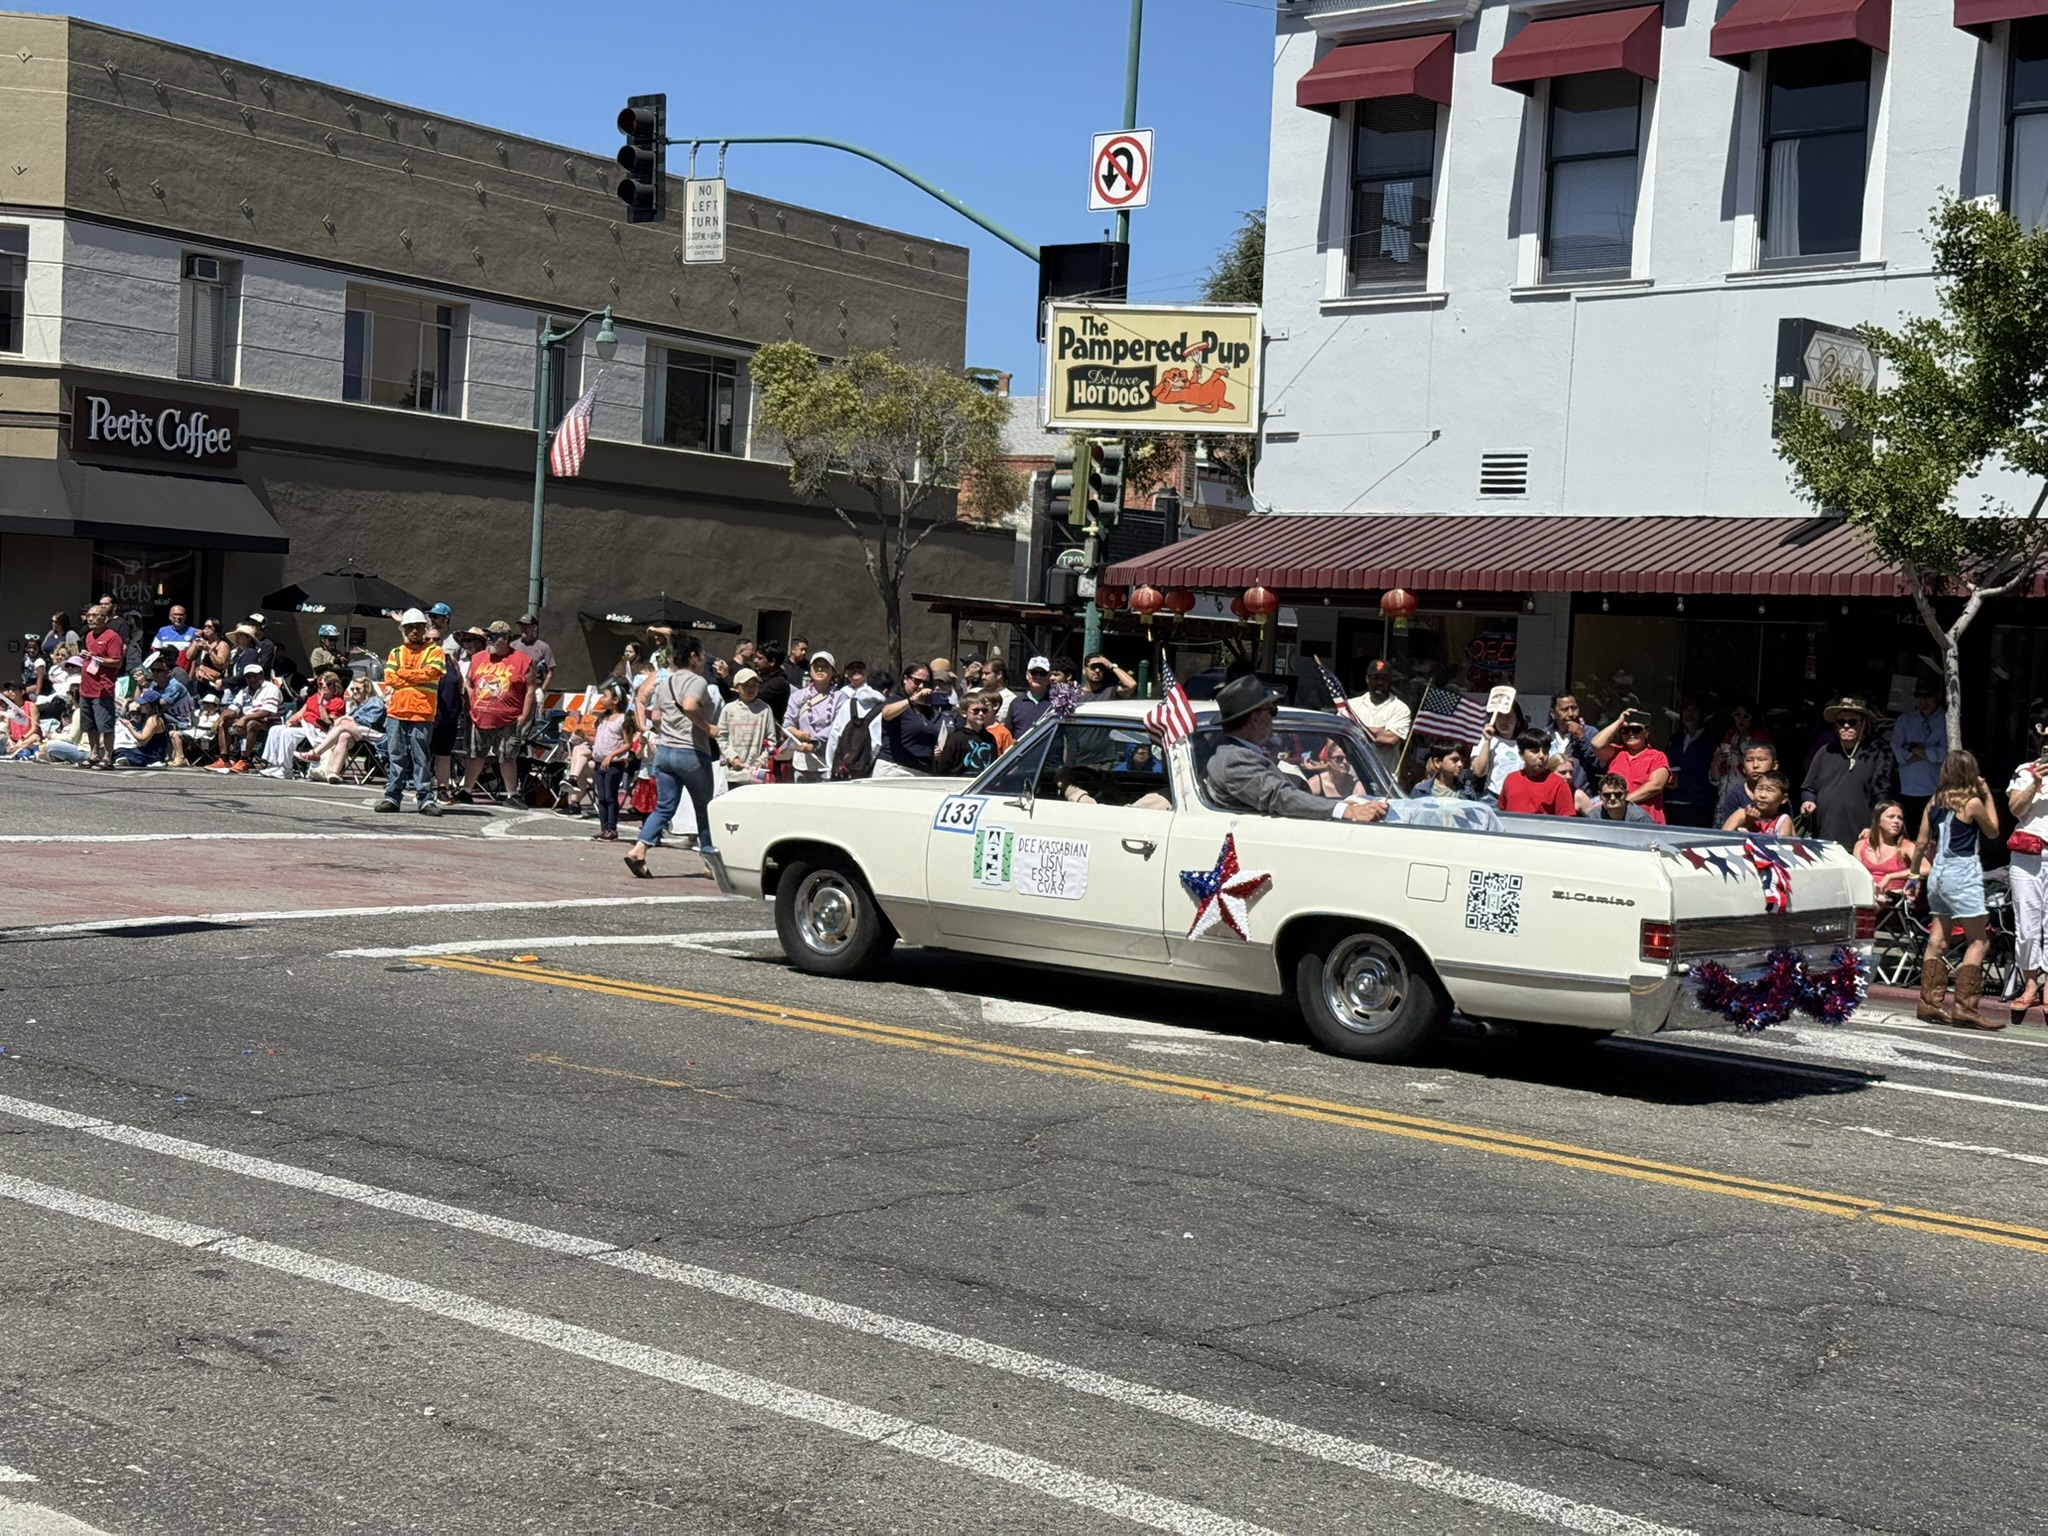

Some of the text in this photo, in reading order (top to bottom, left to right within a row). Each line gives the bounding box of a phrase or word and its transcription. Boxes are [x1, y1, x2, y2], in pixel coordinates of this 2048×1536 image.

[699, 185, 712, 196] NO
[692, 200, 718, 212] LEFT
[691, 216, 719, 227] TURN
[1080, 316, 1109, 336] The
[1058, 326, 1250, 369] Pampered Pup
[1087, 369, 1141, 386] Deluxe
[1073, 380, 1150, 407] HOT DOGS
[86, 396, 231, 458] Peet's Coffee
[1471, 639, 1517, 662] OPE
[940, 802, 979, 825] 133
[1018, 837, 1089, 858] DEE KASSABIAN
[1040, 854, 1064, 871] USN
[1031, 867, 1067, 884] ESSEX
[1037, 881, 1065, 896] CVA9
[1552, 890, 1635, 907] El Camino
